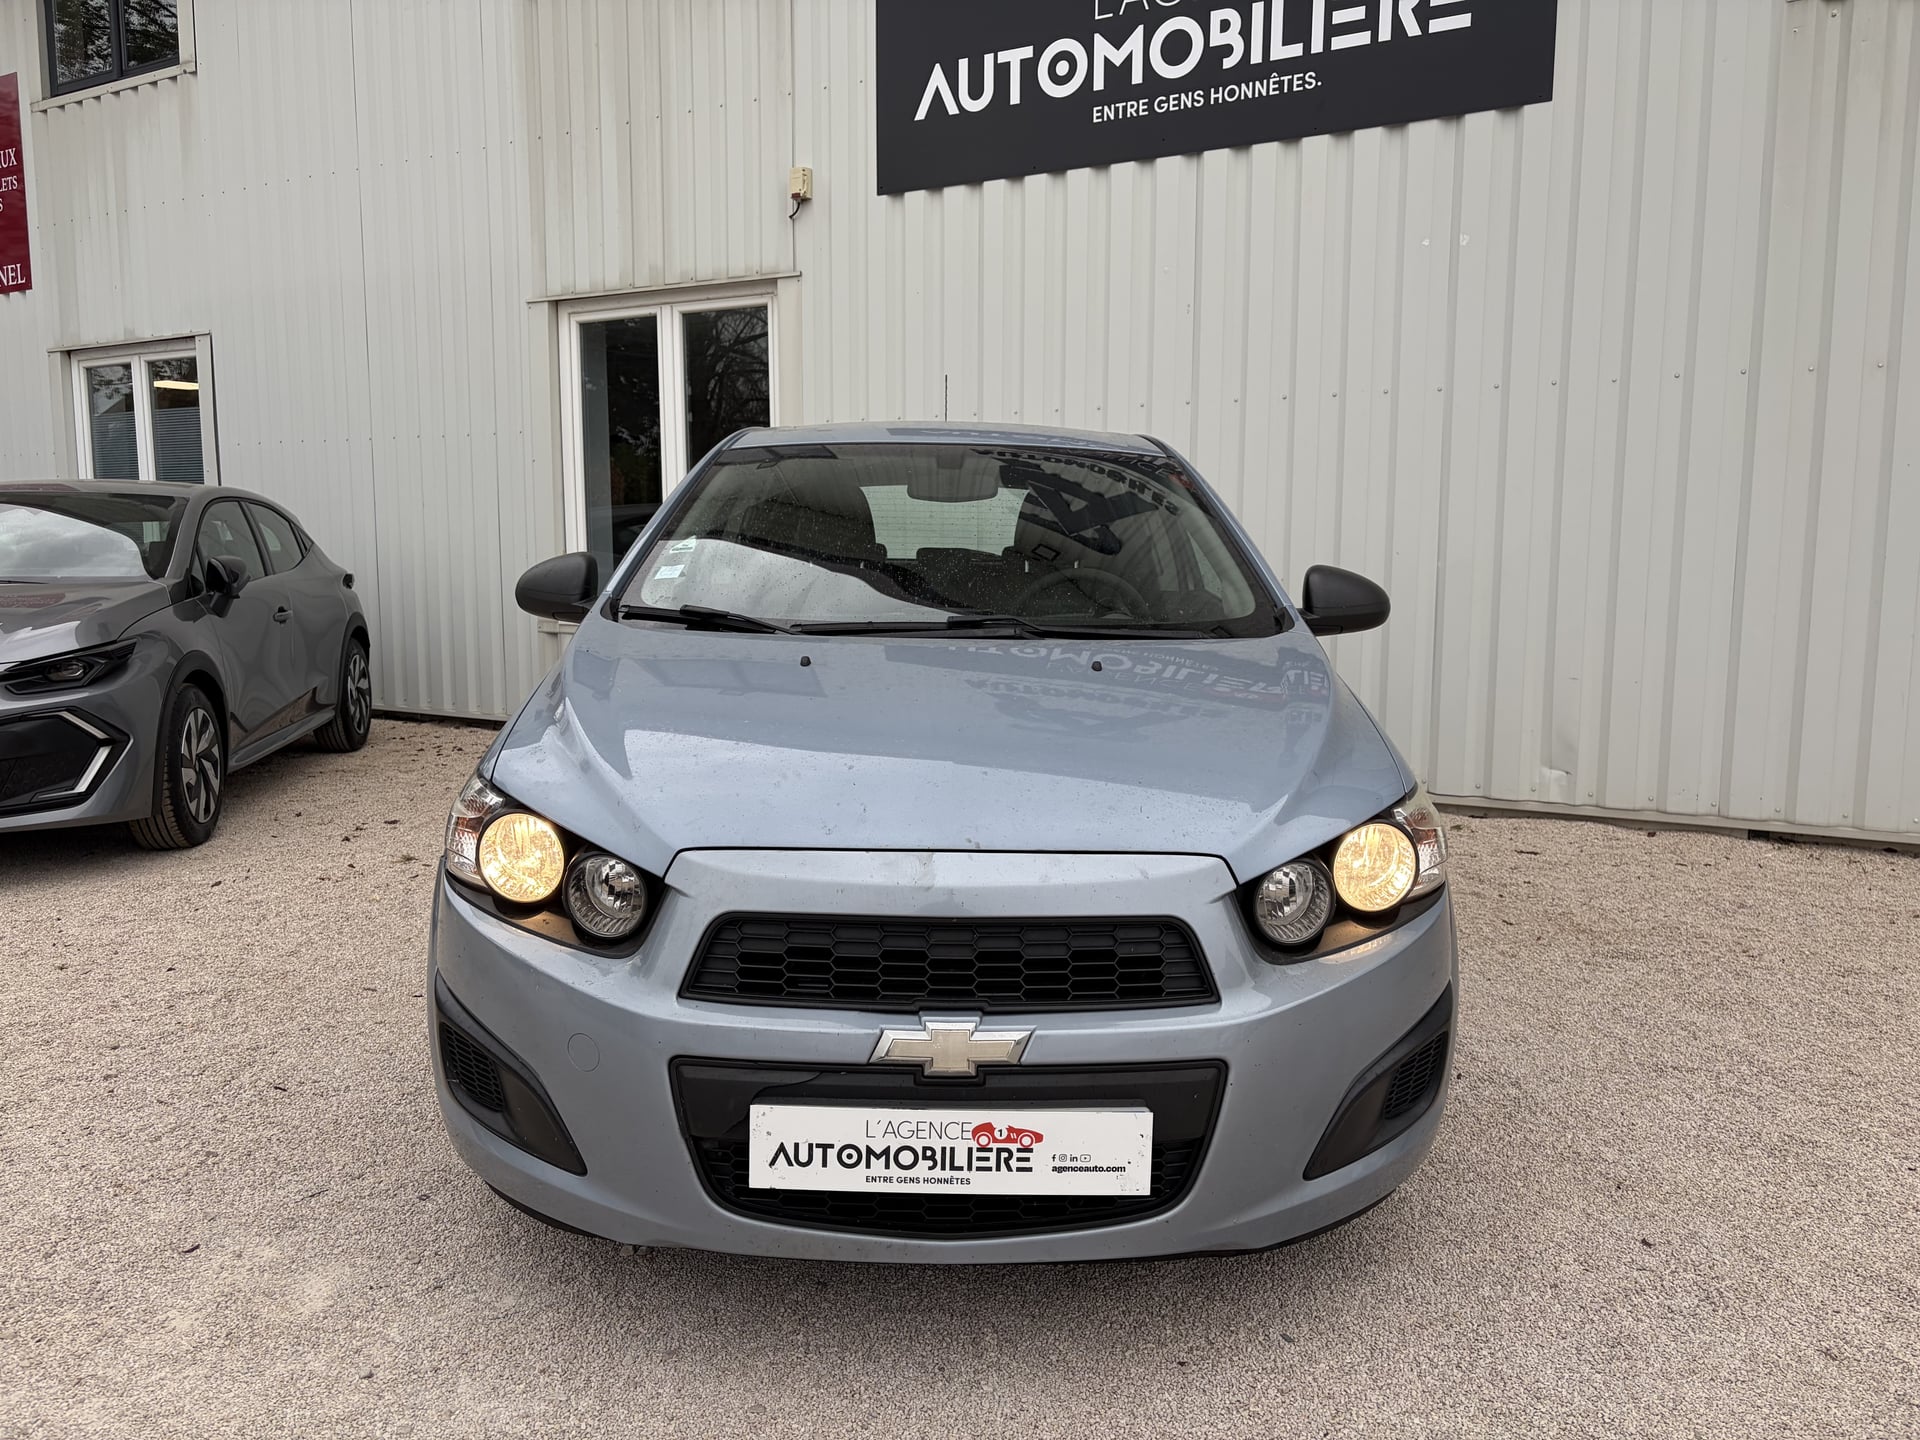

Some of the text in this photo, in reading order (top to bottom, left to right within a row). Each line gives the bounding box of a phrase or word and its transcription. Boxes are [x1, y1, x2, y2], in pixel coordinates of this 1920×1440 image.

[1092, 71, 1322, 123] ENTRE GENS HONNÊTES.
[866, 1119, 973, 1141] L'AGENCE
[1051, 1165, 1126, 1174] agenceauto.com
[865, 1175, 971, 1186] ENTRE GENS HONNÊTES
